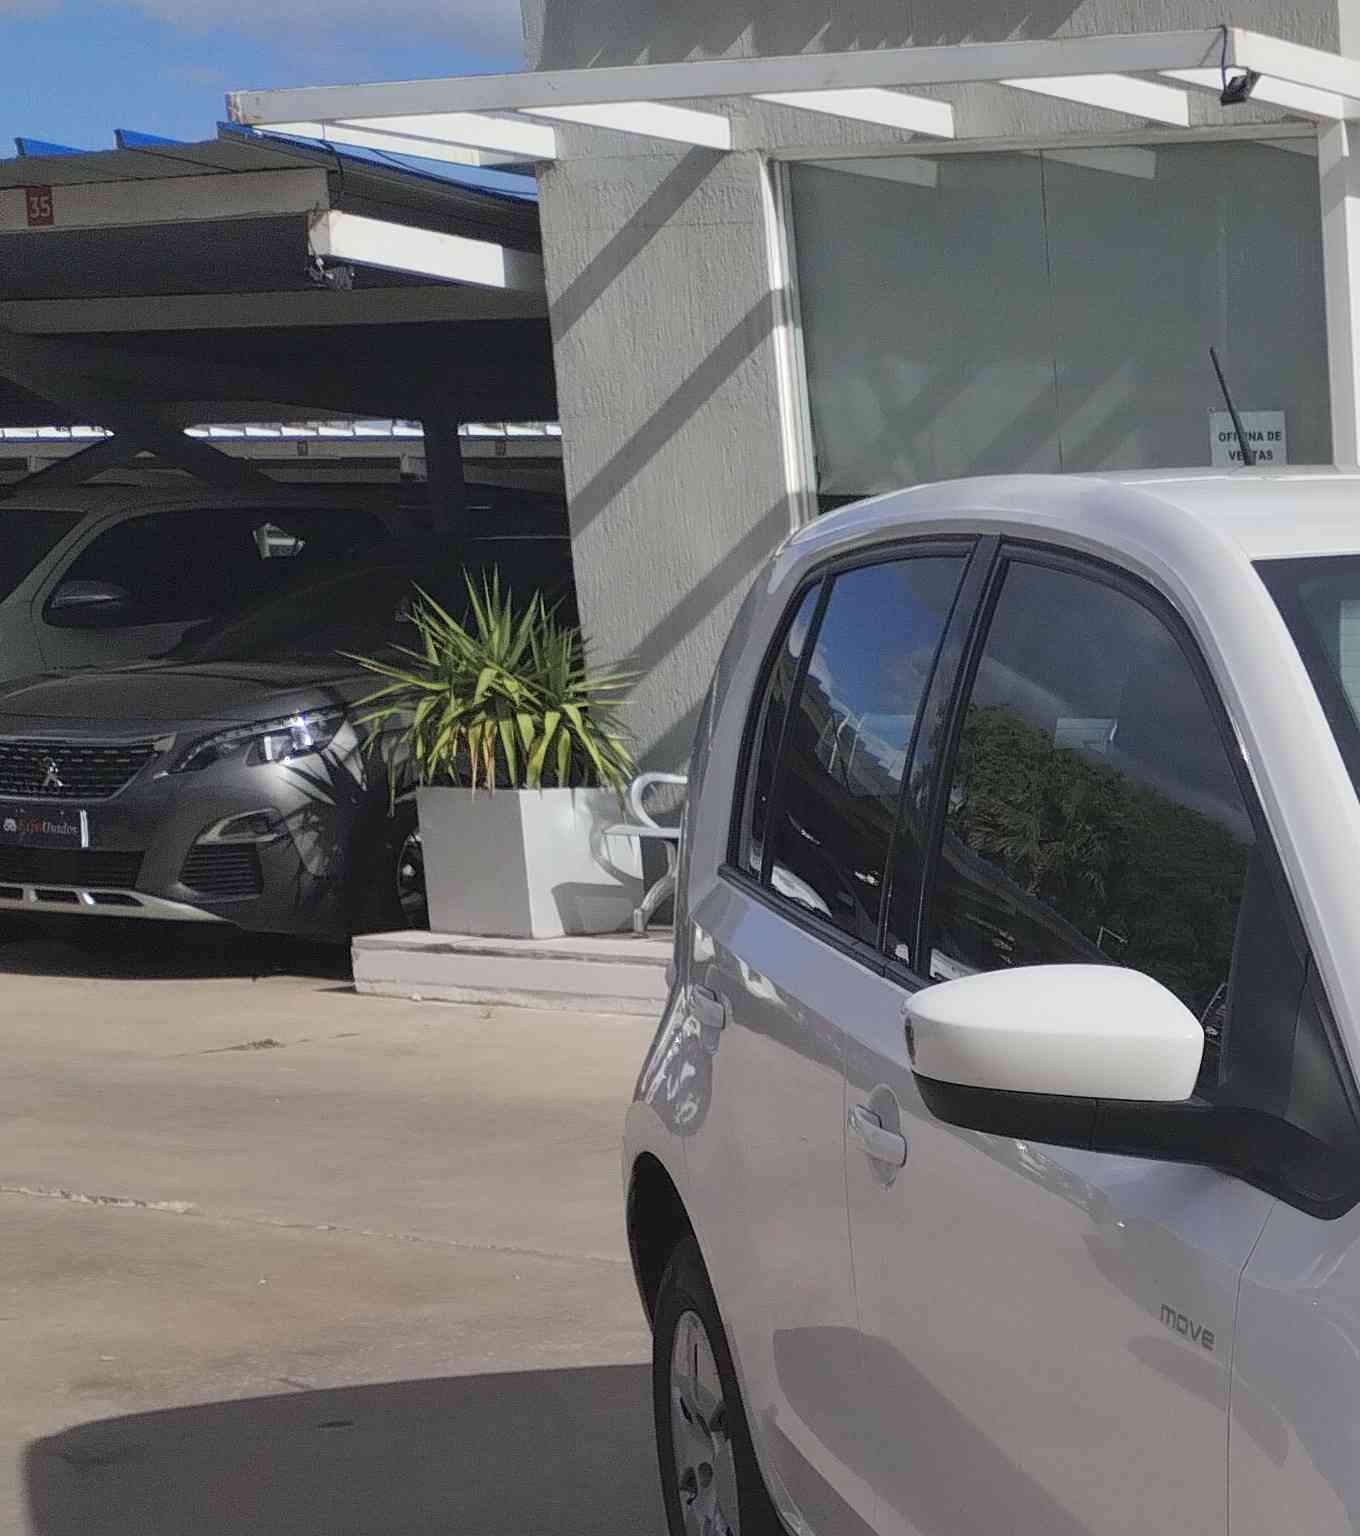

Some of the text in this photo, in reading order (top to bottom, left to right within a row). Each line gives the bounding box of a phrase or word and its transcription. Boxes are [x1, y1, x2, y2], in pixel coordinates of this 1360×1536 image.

[28, 196, 51, 218] 35
[1218, 431, 1281, 442] OFIINA DE
[1160, 1303, 1215, 1351] move
